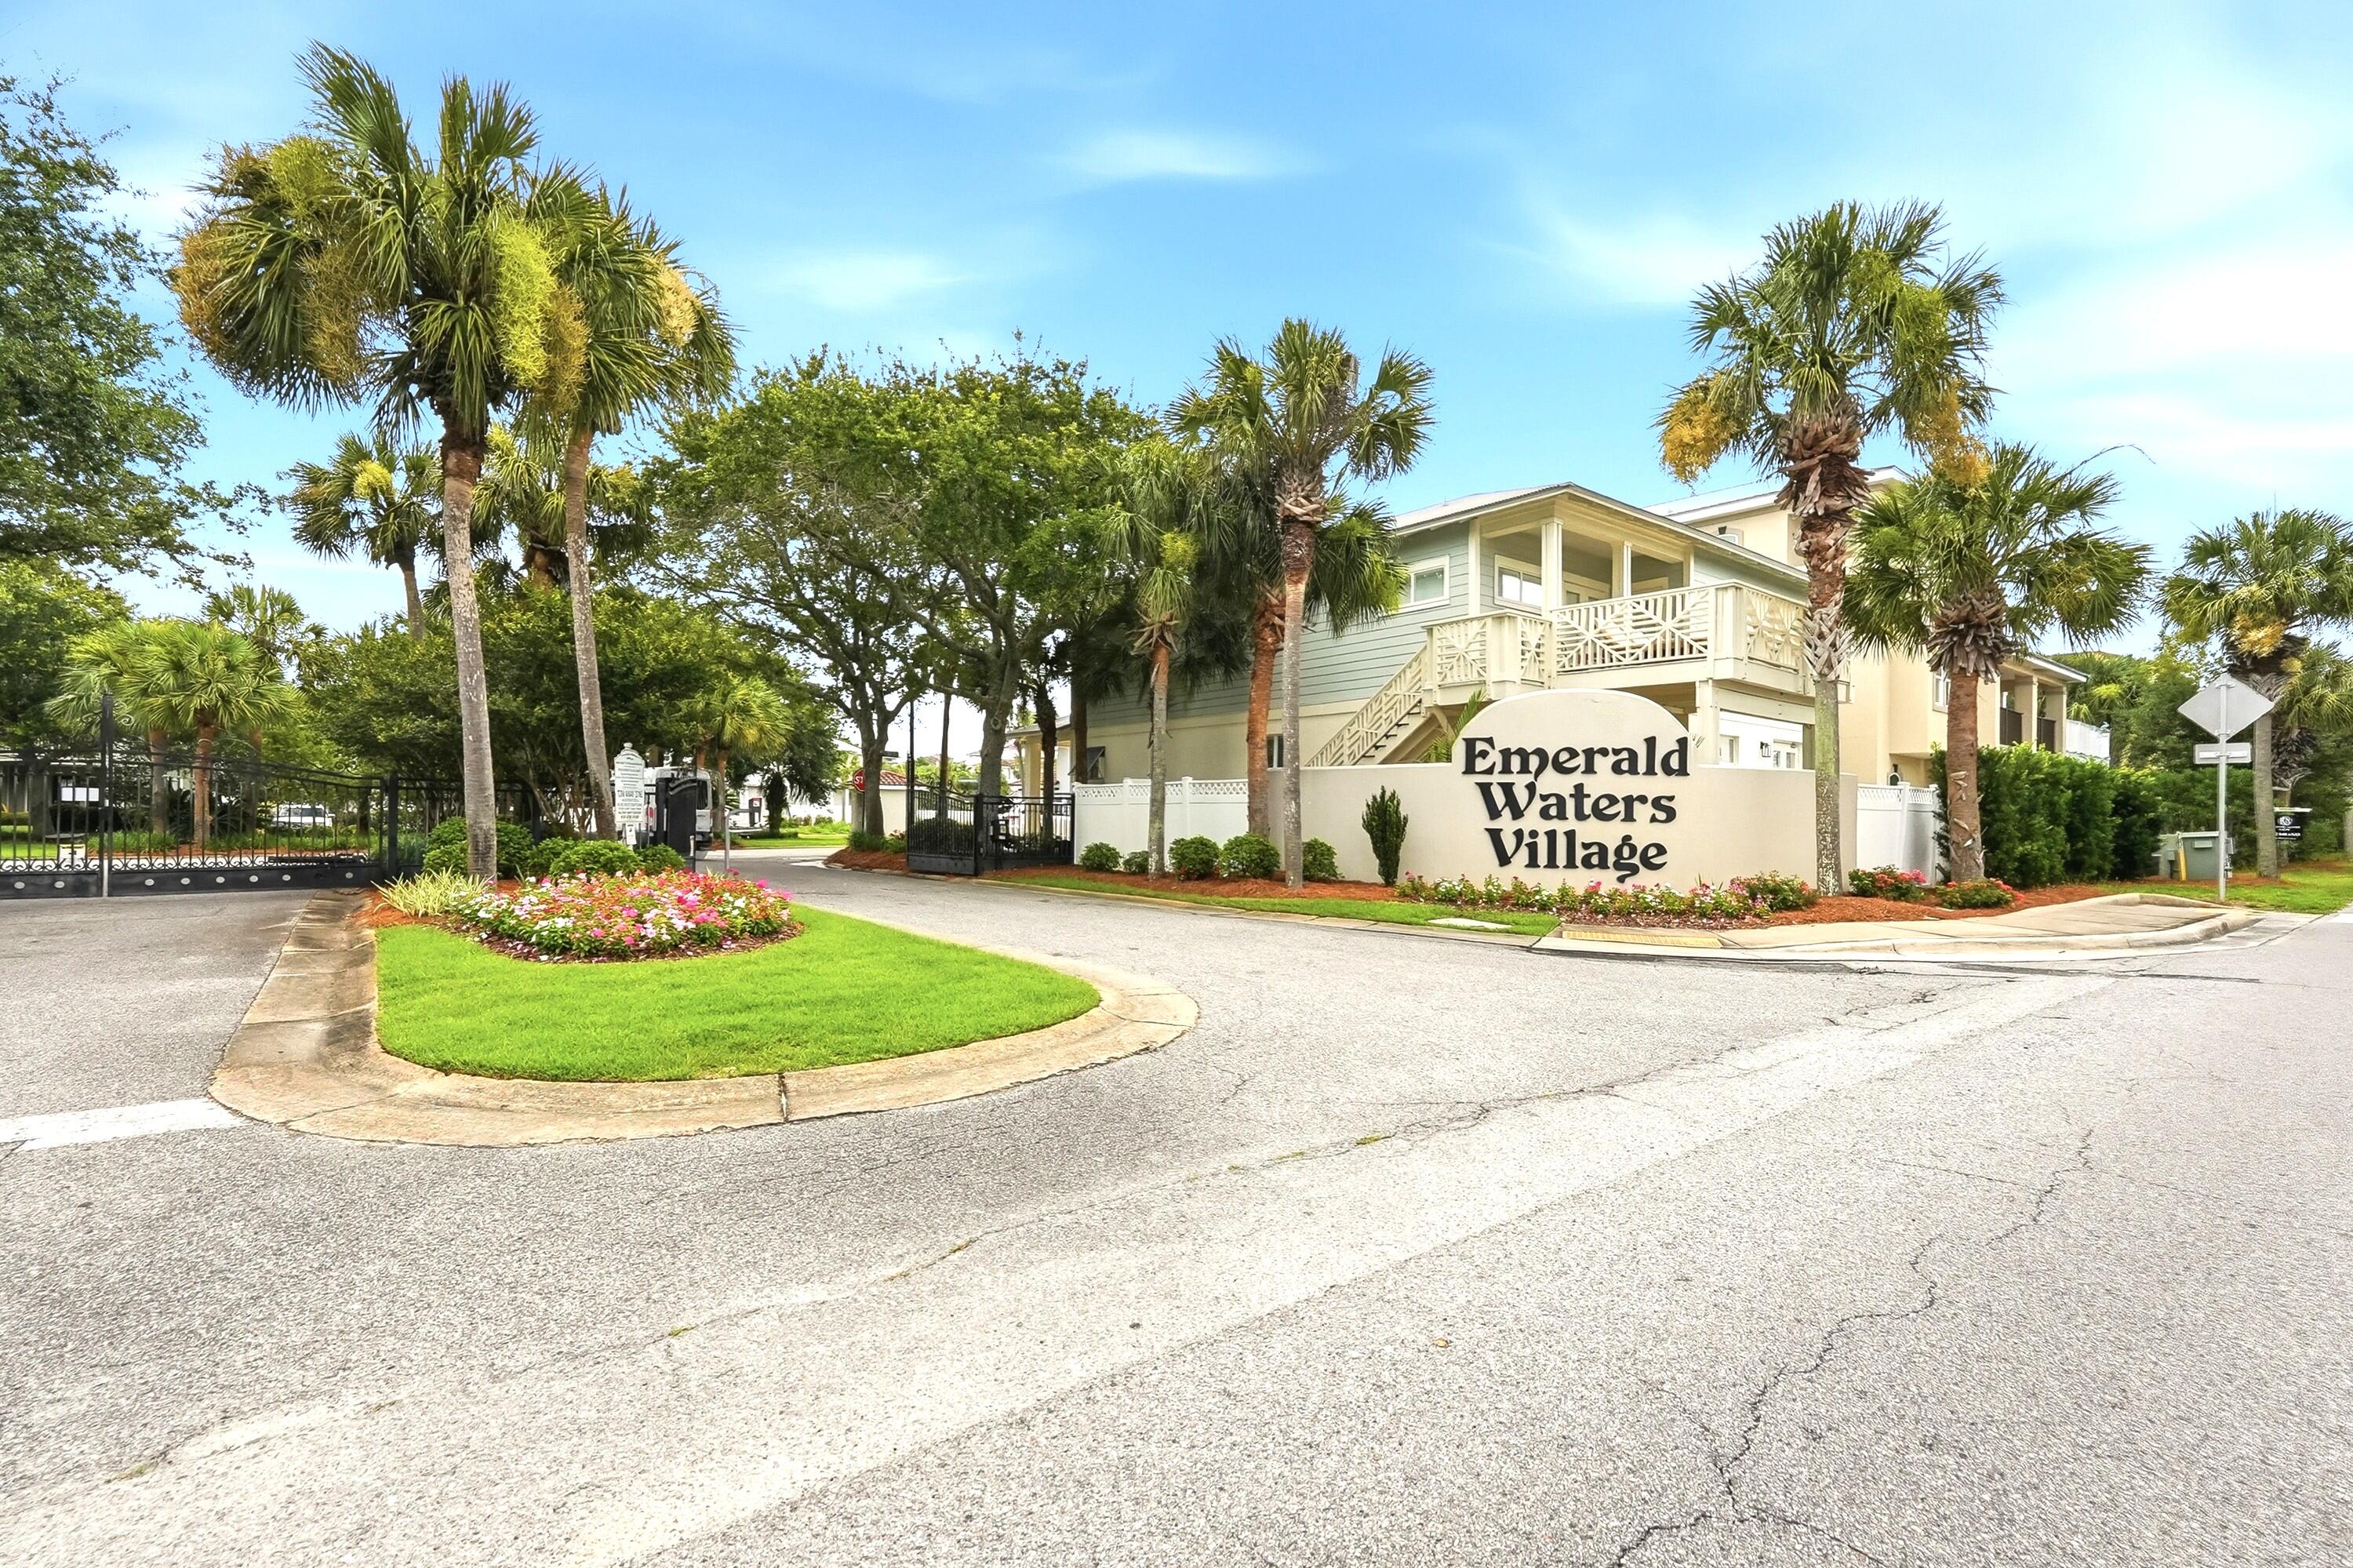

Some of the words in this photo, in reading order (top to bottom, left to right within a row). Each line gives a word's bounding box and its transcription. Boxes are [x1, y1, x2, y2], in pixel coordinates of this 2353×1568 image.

[1461, 736, 1690, 782] Emerald
[1474, 780, 1677, 824] Waters
[1484, 828, 1667, 884] Village
